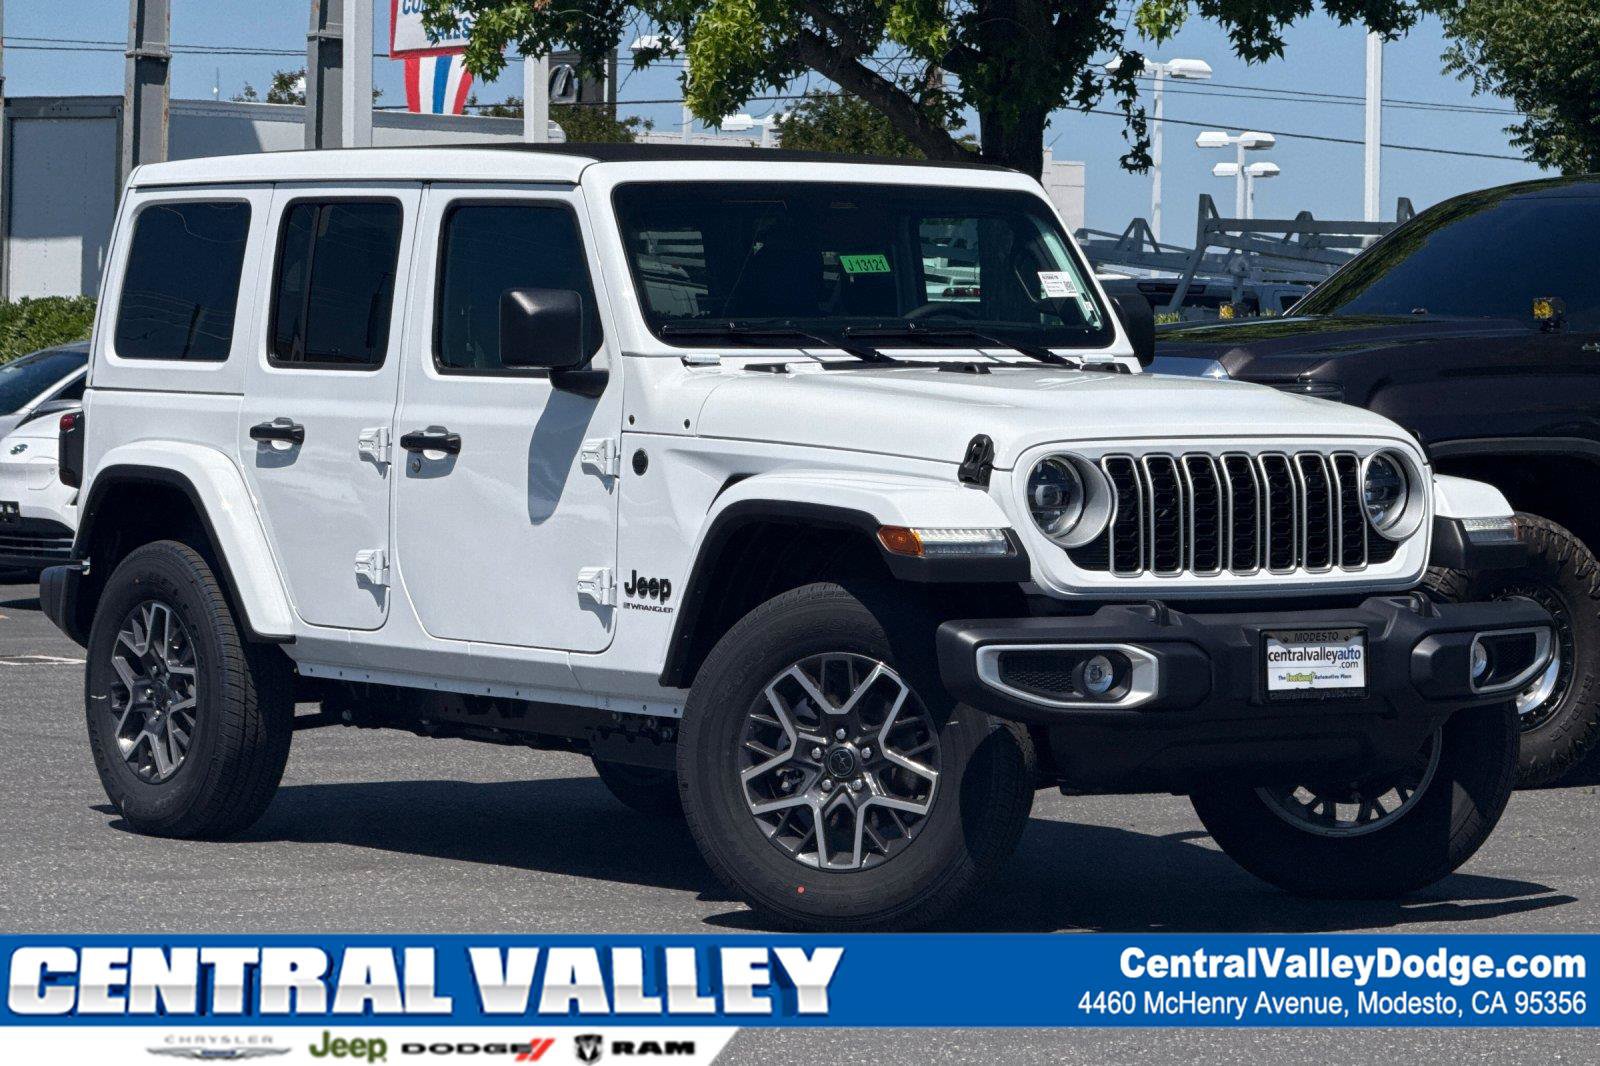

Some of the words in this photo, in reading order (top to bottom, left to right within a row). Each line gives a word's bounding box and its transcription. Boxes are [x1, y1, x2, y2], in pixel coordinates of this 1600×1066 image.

[624, 569, 672, 605] Jeep
[631, 602, 674, 613] WRANGLER
[1294, 631, 1339, 642] MODESTO
[1268, 646, 1361, 664] centralvalleyauto
[1339, 661, 1359, 669] .com
